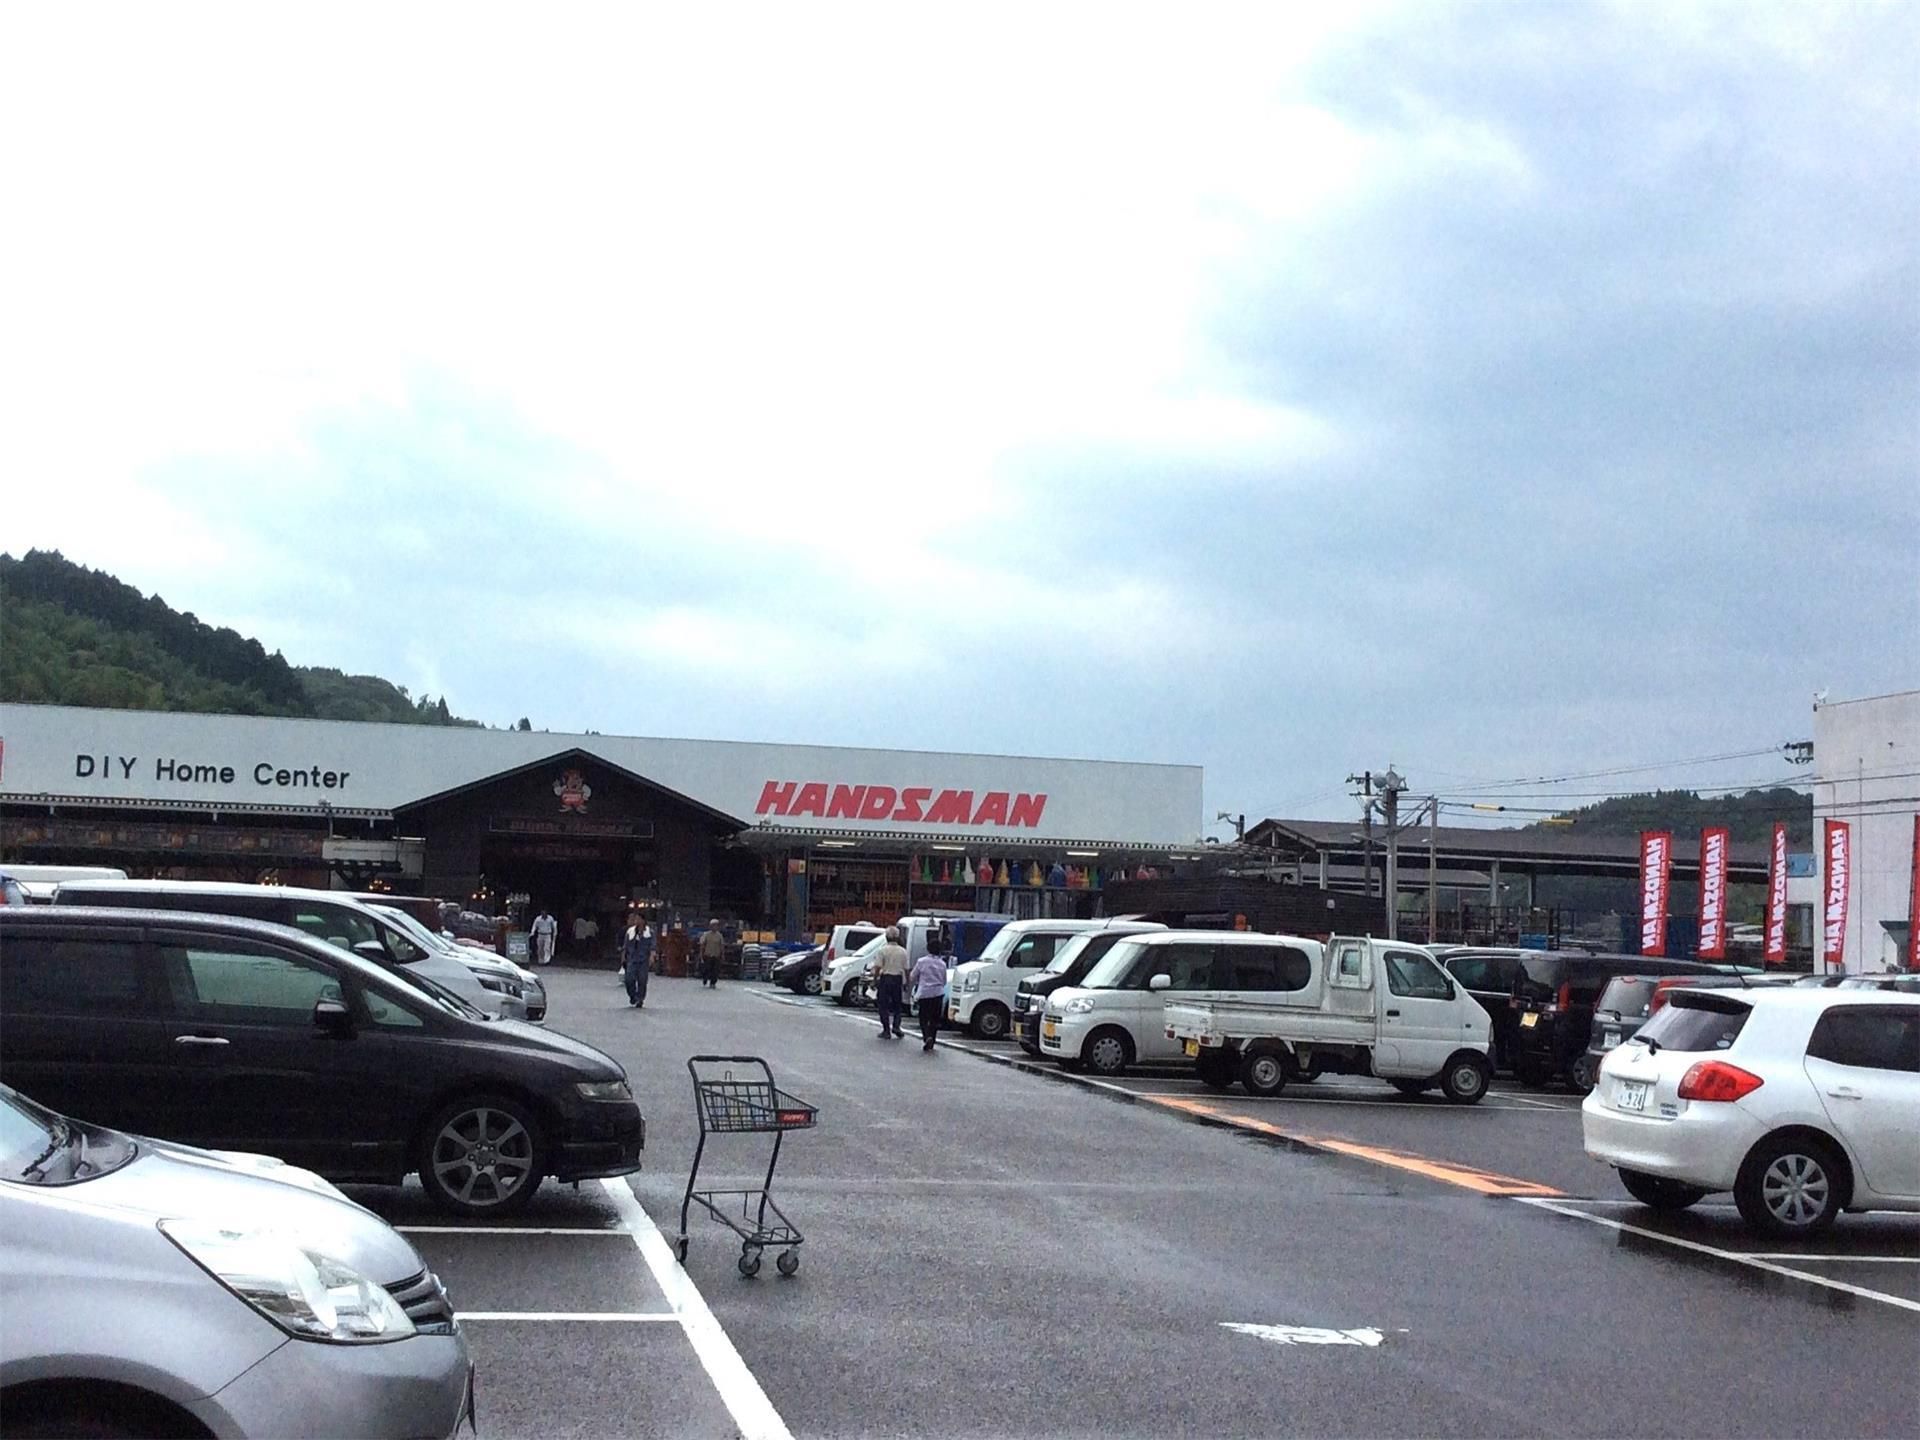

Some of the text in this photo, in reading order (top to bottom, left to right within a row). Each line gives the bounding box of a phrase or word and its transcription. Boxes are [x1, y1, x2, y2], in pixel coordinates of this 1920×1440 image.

[75, 754, 350, 789] DIY Home Center
[755, 780, 1048, 828] HANDSMAN
